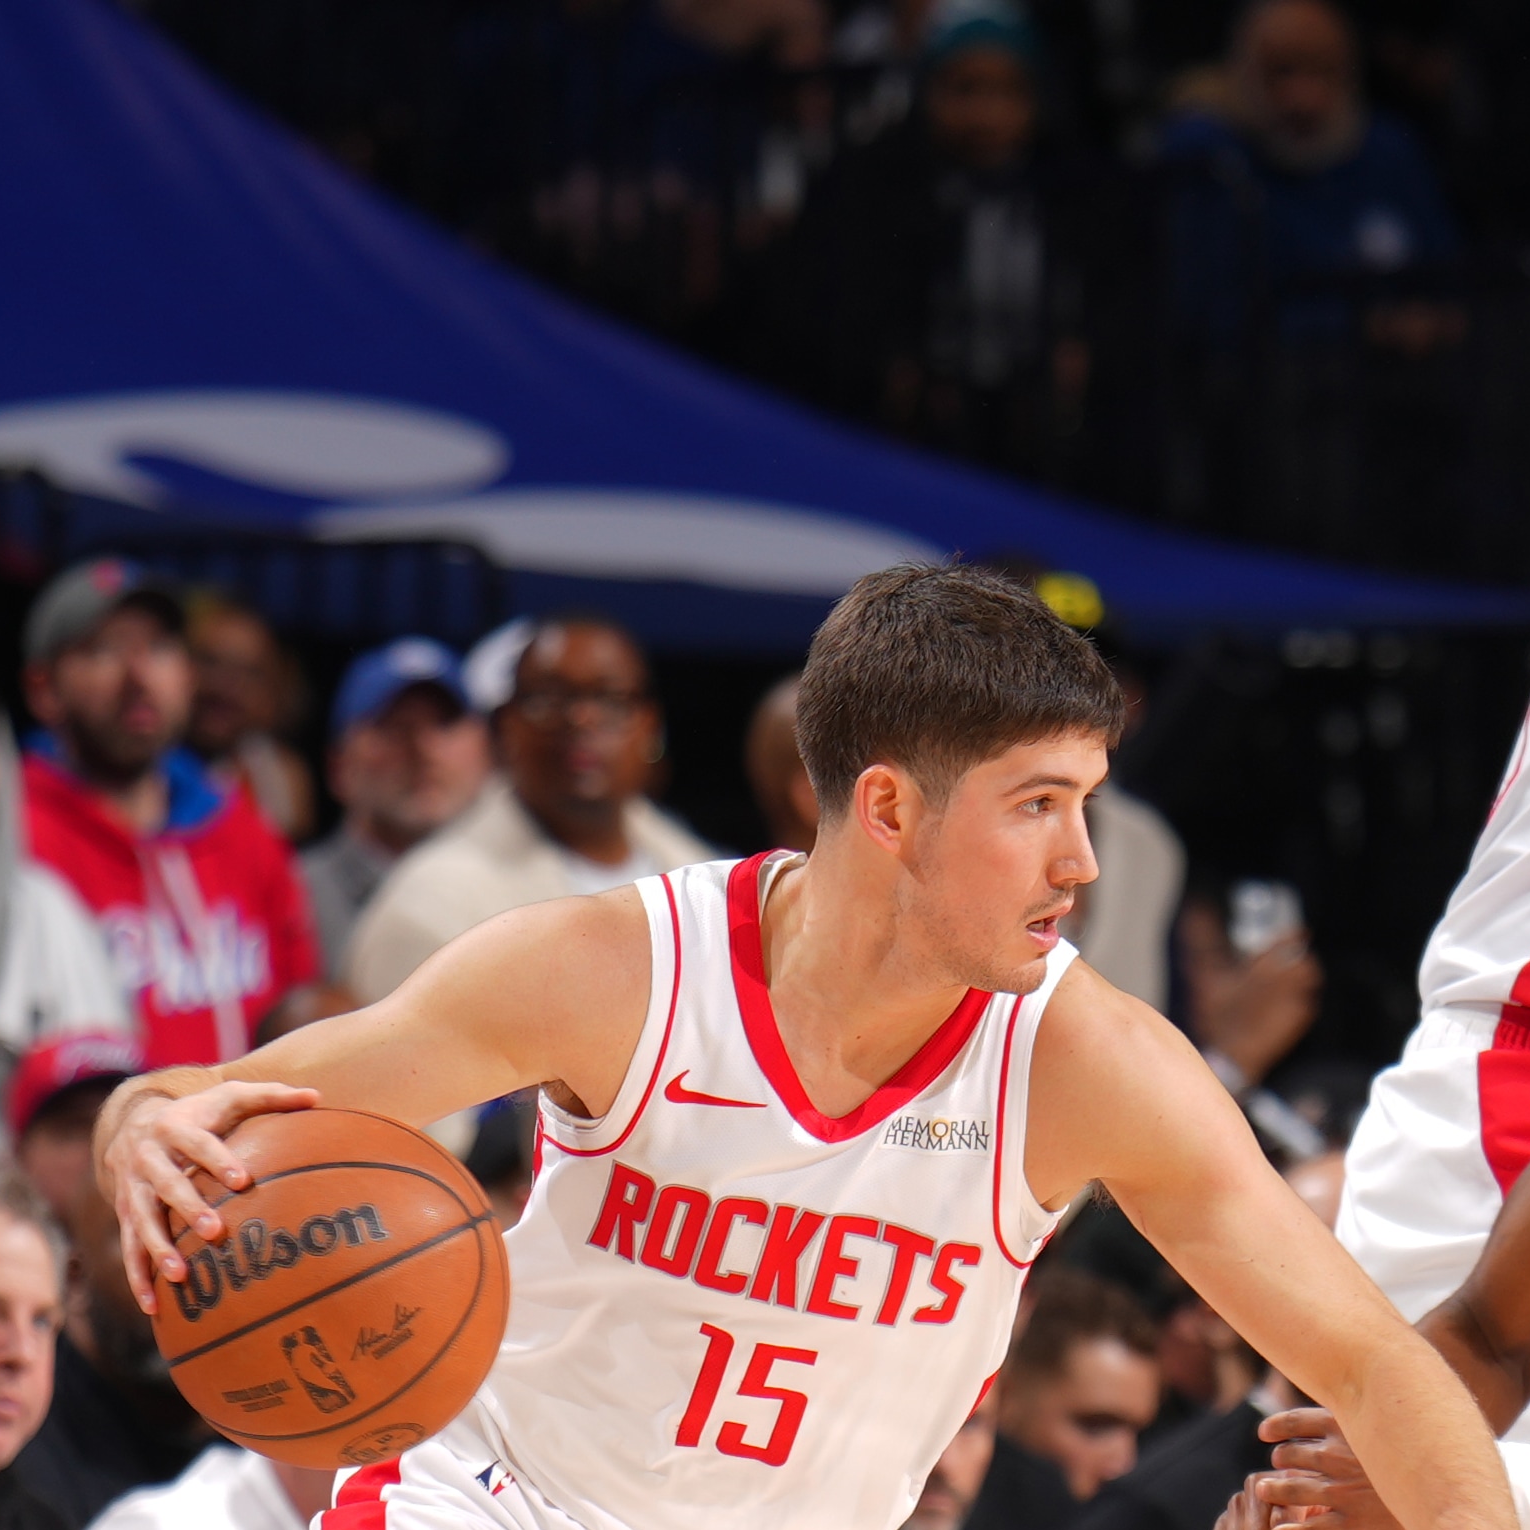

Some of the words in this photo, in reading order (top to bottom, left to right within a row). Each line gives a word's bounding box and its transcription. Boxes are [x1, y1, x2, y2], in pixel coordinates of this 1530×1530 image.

[884, 1130, 989, 1151] HERMANN
[889, 1116, 990, 1138] MEMORIAL
[172, 1203, 391, 1322] Wilson
[585, 1159, 982, 1328] ROCKETS
[675, 1322, 818, 1467] 15
